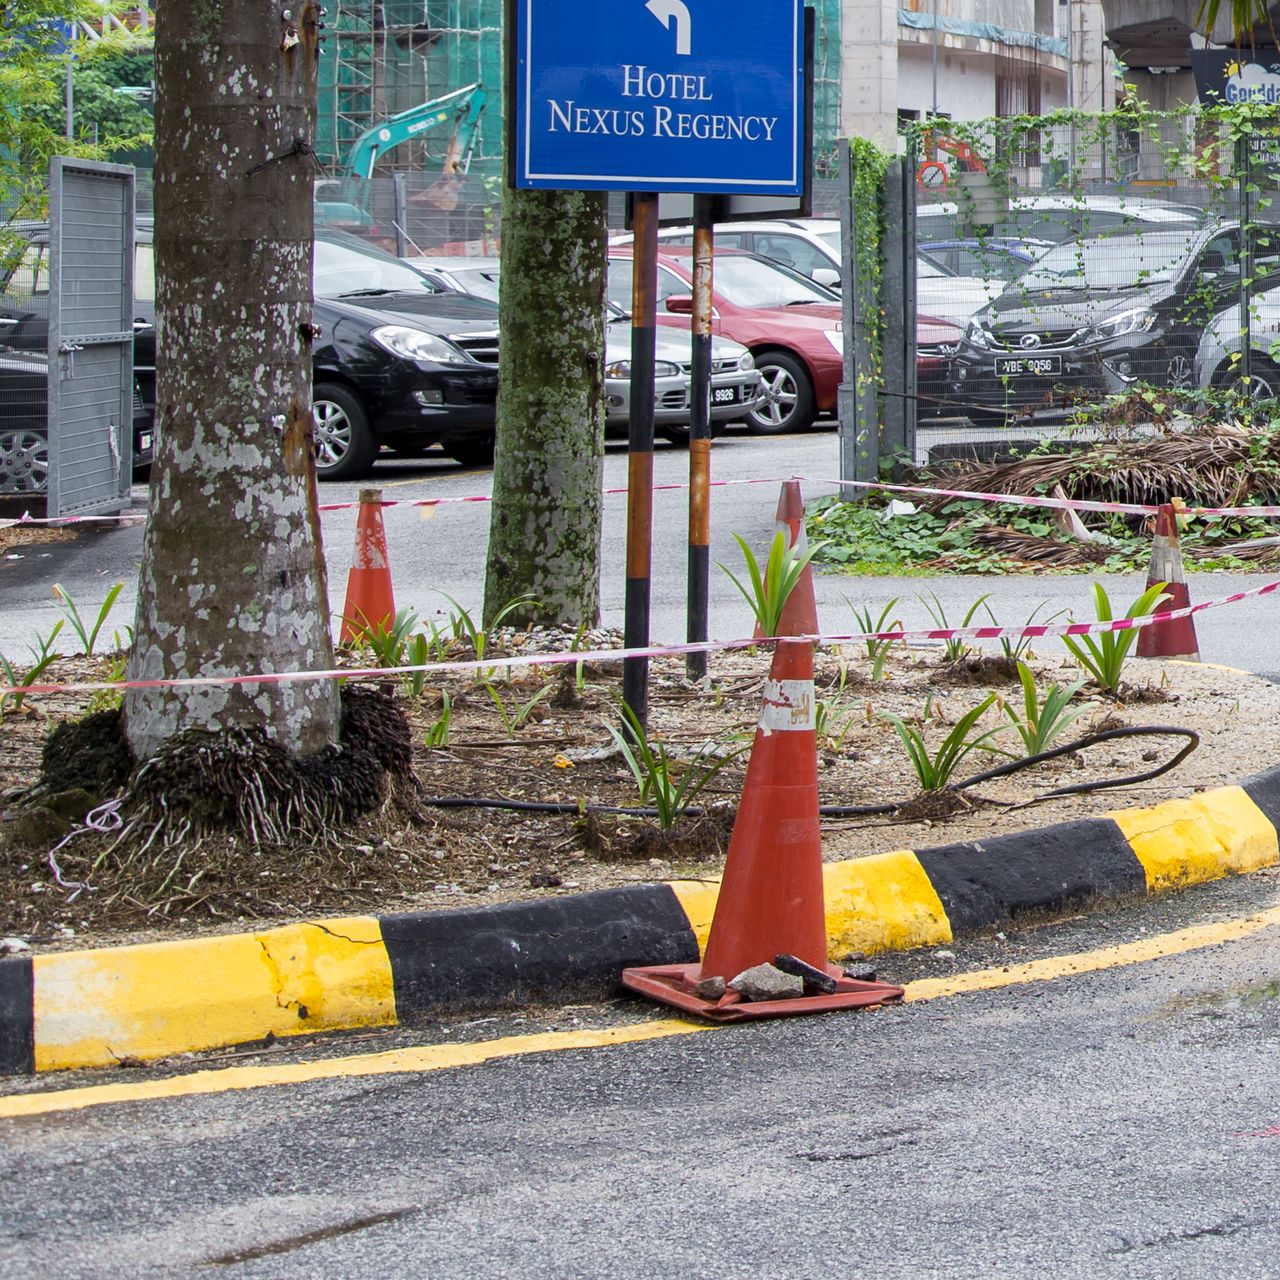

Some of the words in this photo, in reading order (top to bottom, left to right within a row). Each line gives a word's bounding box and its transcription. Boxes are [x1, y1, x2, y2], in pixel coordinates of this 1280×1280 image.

[621, 64, 713, 101] HOTEL
[547, 99, 646, 137] NEXUS
[652, 105, 779, 142] REGENCY
[715, 388, 734, 402] 9926
